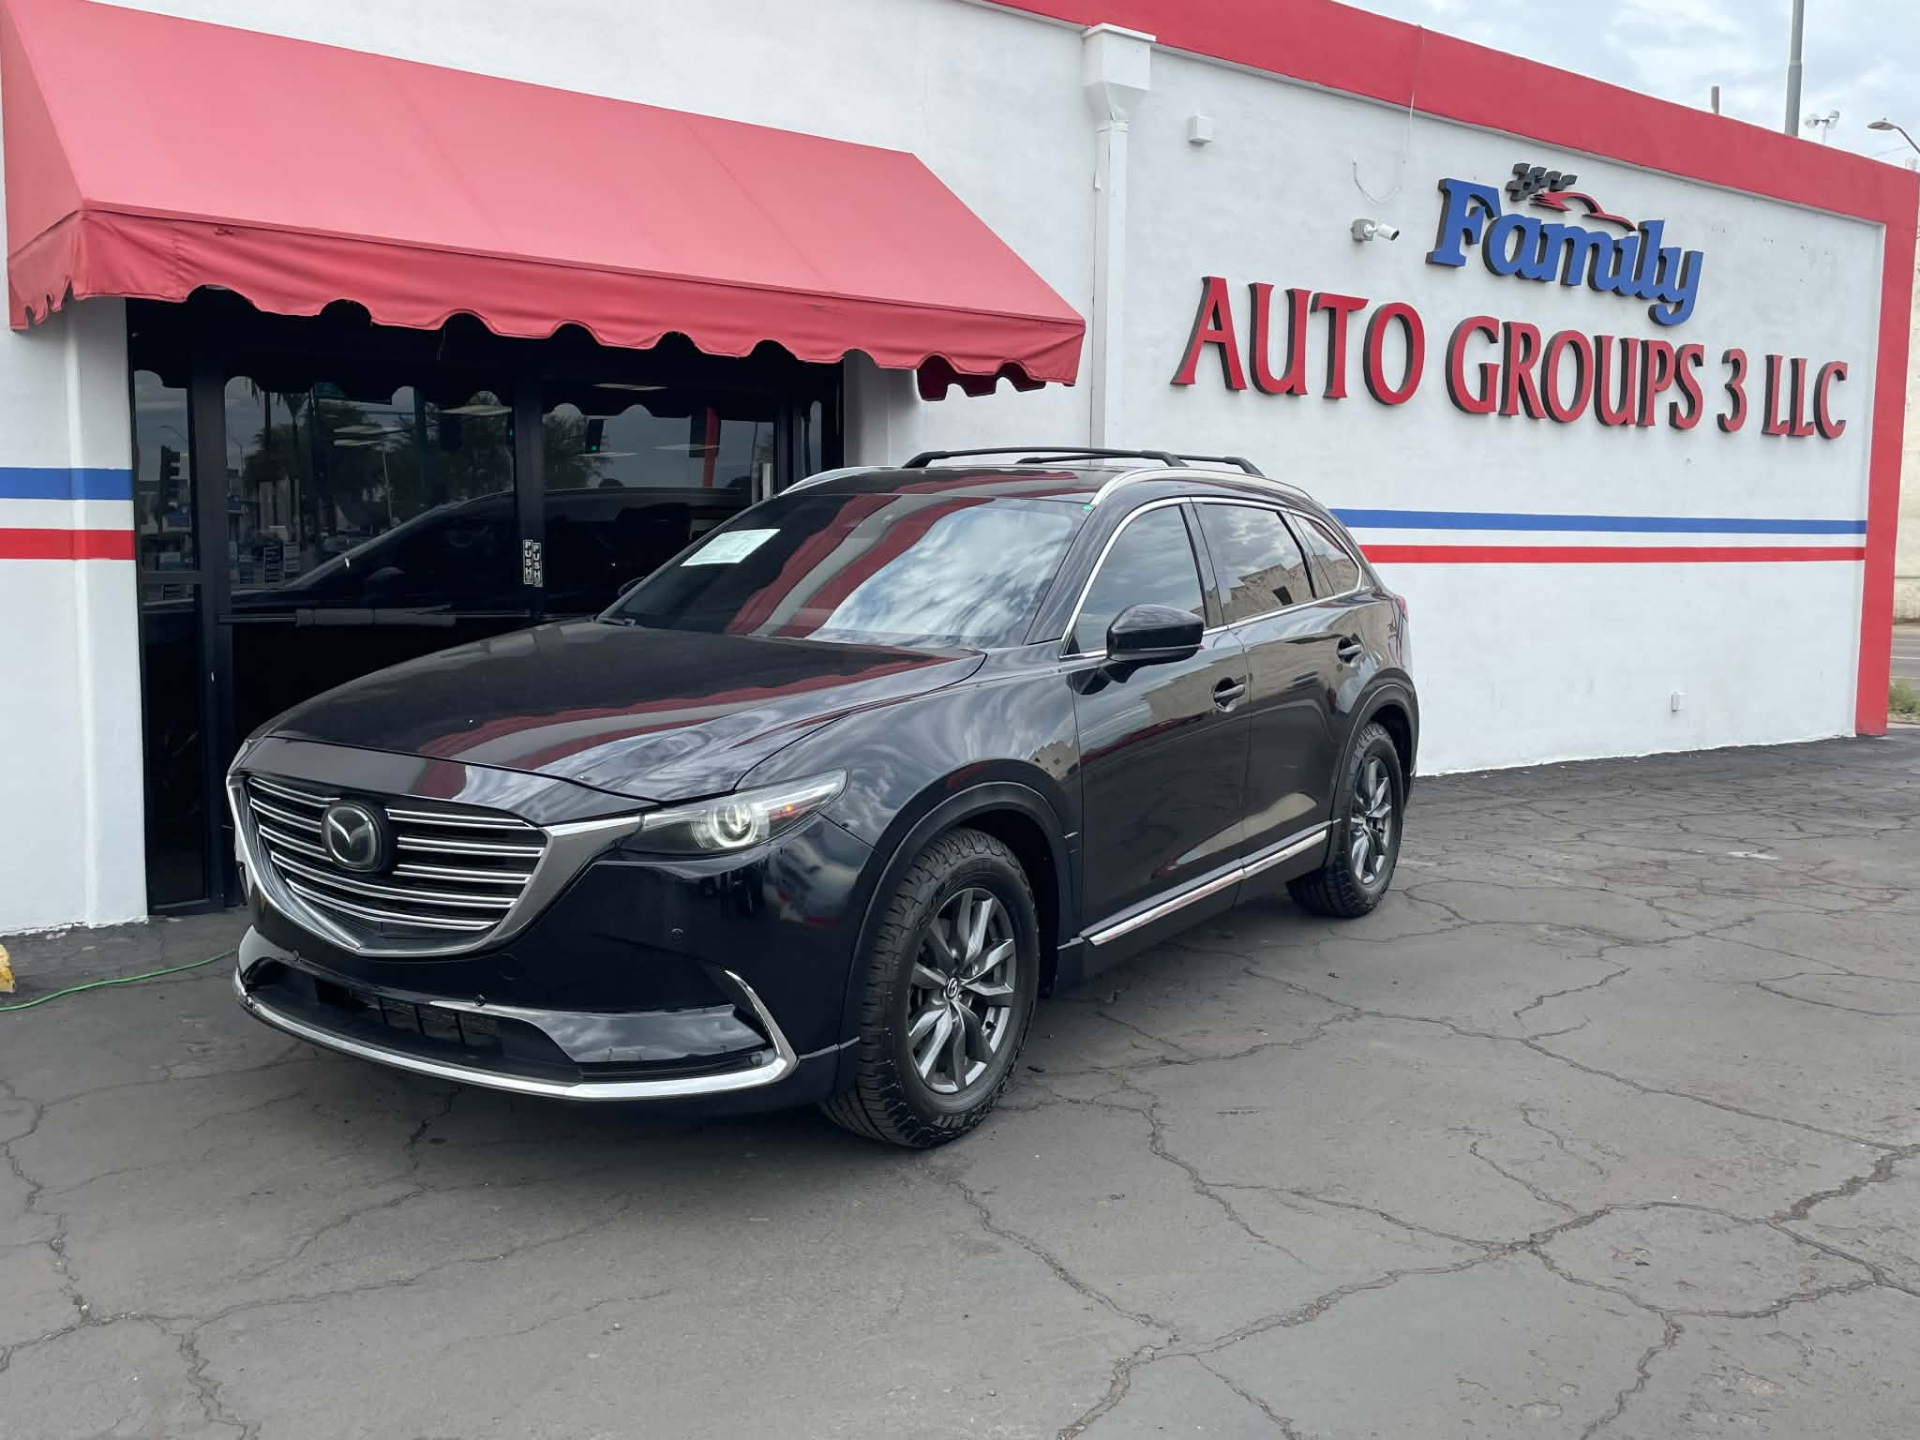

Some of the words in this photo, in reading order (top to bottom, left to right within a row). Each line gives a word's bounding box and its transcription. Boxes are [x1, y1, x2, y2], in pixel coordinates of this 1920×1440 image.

[1426, 178, 1703, 326] Family
[1170, 276, 1425, 405] AUTO
[1445, 316, 1704, 429] GROUPS
[1717, 348, 1747, 432] 3
[1761, 354, 1848, 439] LLC
